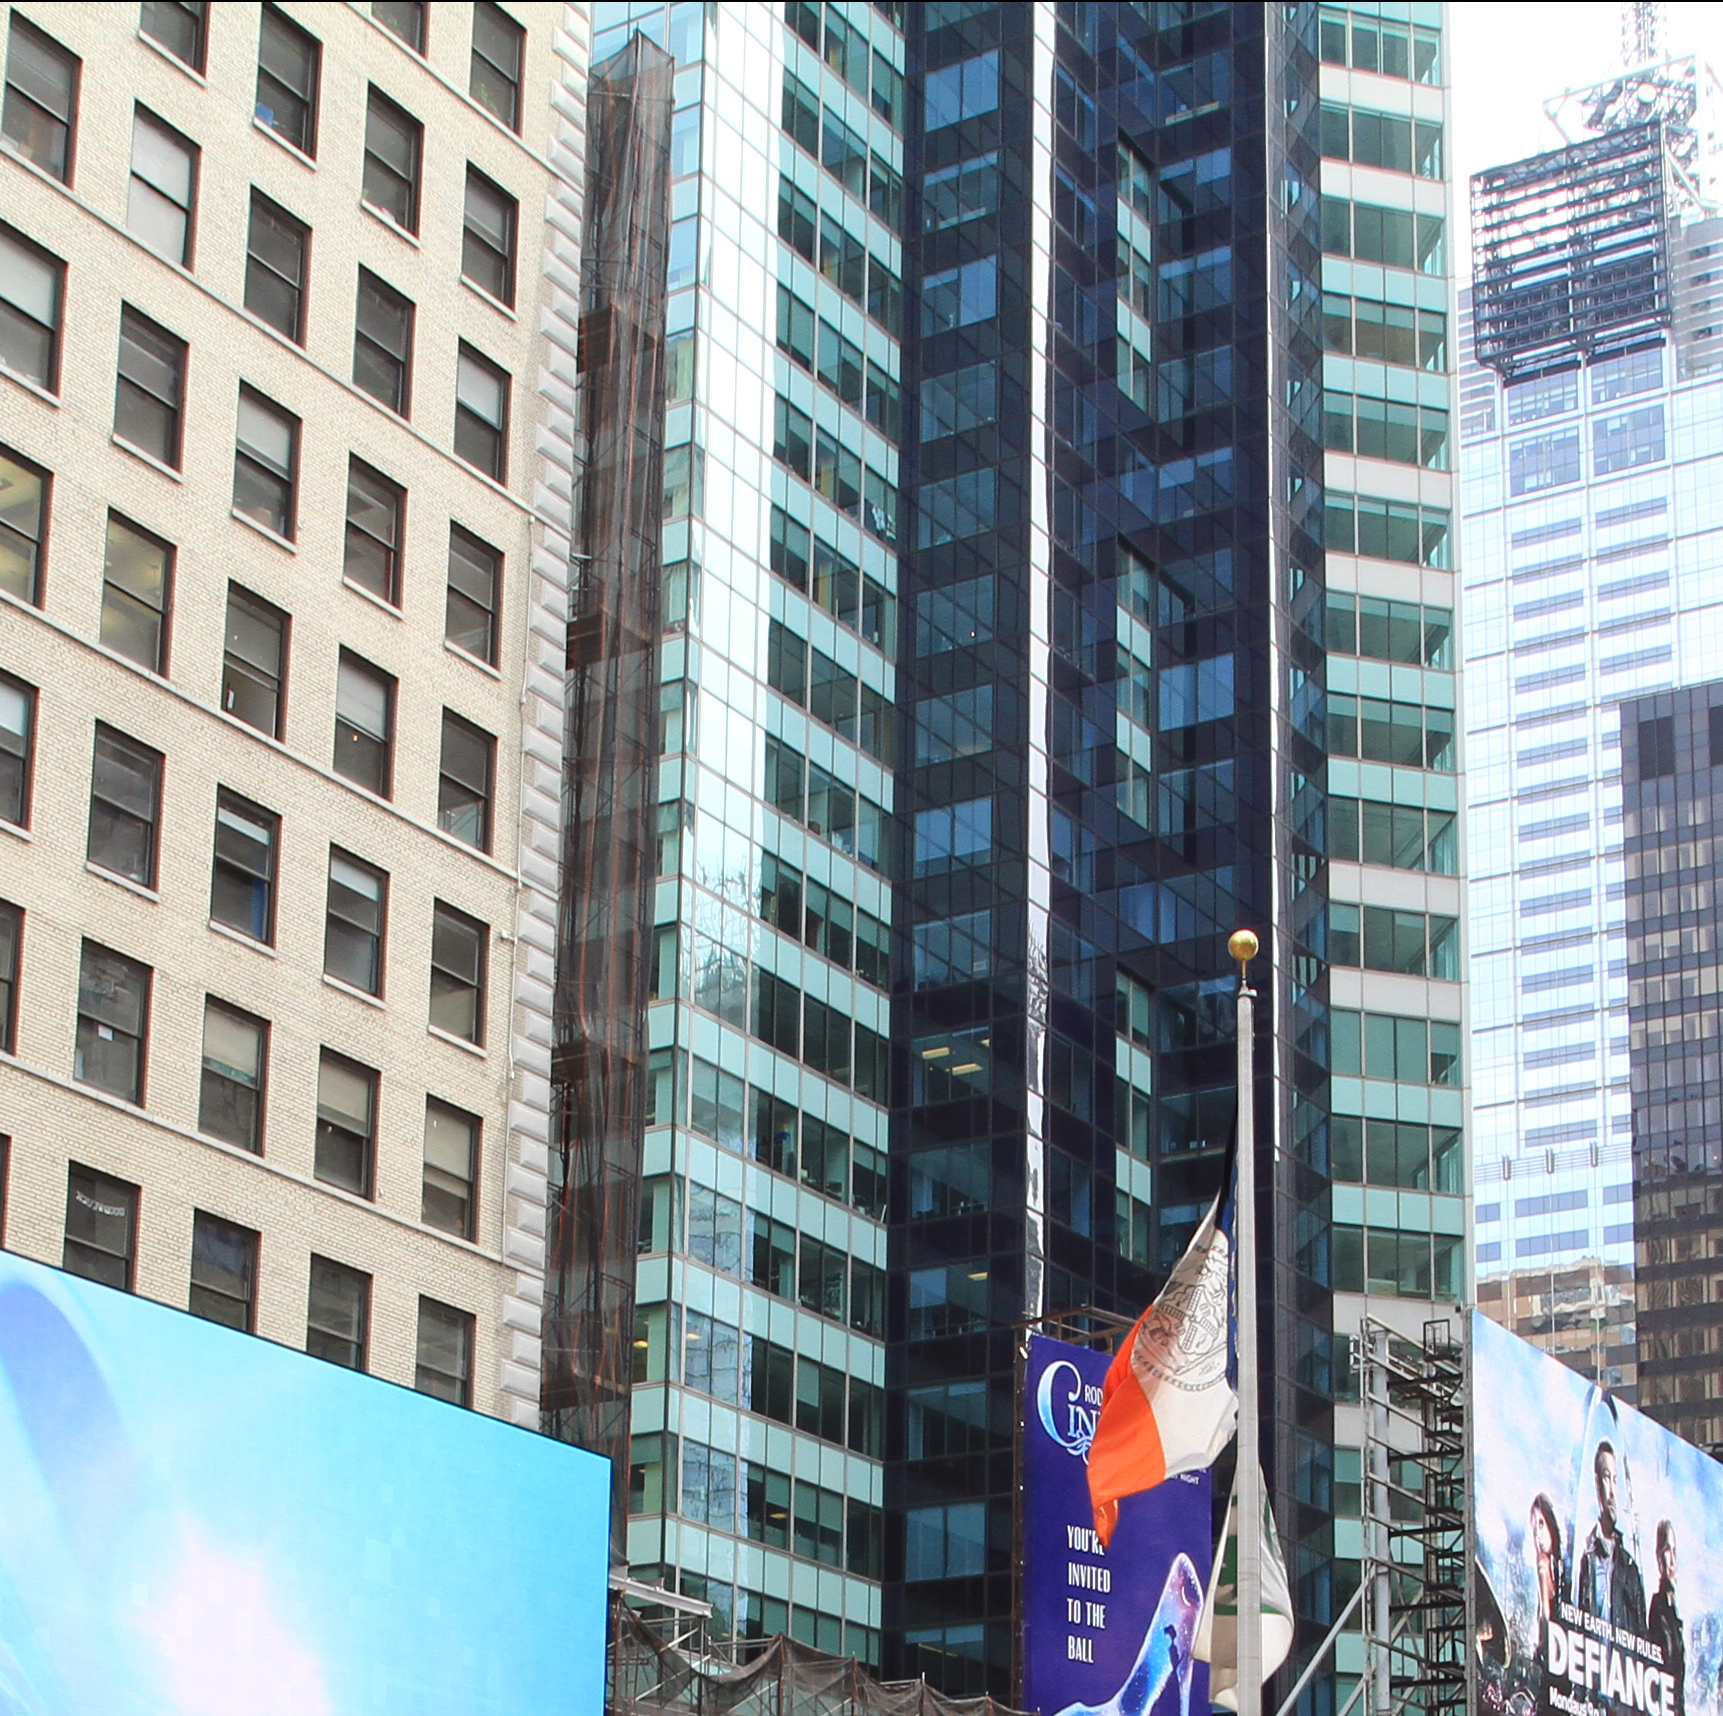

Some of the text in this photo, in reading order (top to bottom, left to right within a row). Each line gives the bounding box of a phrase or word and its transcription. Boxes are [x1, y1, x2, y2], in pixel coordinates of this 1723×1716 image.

[1068, 1562, 1111, 1593] INVITED
[1067, 1598, 1105, 1629] TO THE
[1561, 1601, 1665, 1665] NEW EARTH. NEW RULES.
[1068, 1636, 1094, 1664] BALL
